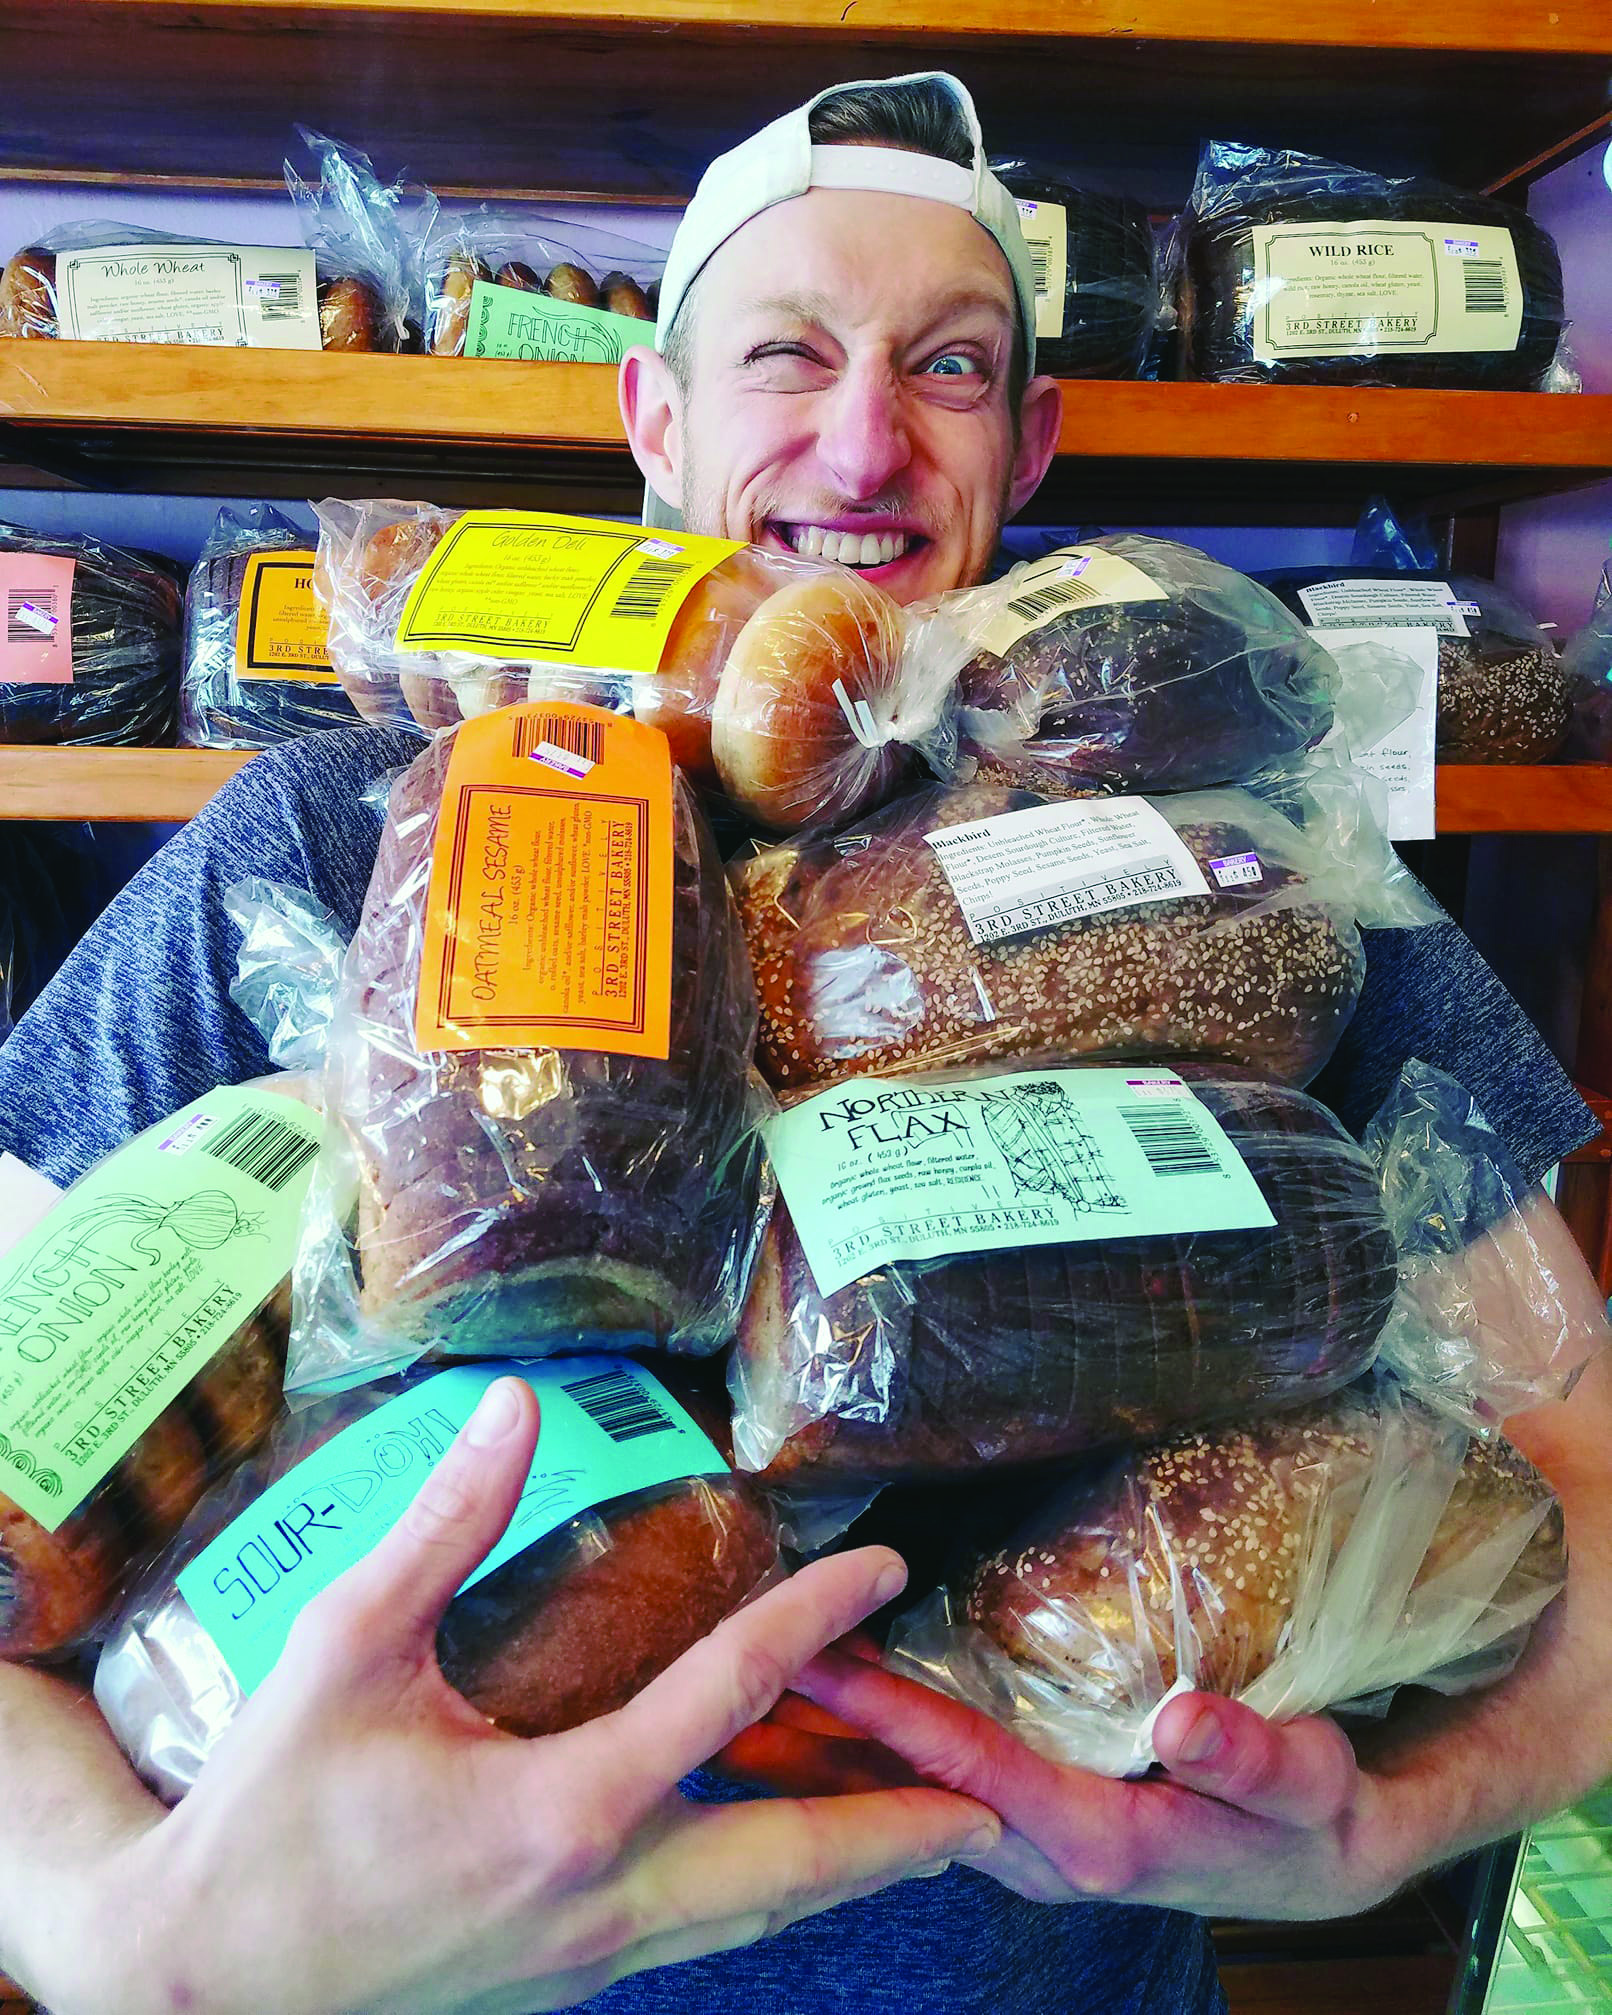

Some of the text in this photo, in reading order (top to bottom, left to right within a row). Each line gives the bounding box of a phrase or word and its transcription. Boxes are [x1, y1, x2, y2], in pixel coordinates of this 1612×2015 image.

[1310, 245, 1394, 256] WILD RICE
[102, 260, 205, 278] Whole Wheat
[508, 313, 587, 352] FRENCH
[1286, 322, 1310, 331] 3RD
[1317, 320, 1363, 329] STREET
[492, 531, 588, 550] Golden Deli
[1306, 582, 1345, 592] Blackbird
[932, 828, 991, 850] Blackbird
[938, 845, 985, 862] Ingredients:
[987, 832, 1034, 847] Unbleached
[1034, 826, 1060, 835] Wheat
[975, 852, 1004, 862] Desem
[1005, 840, 1048, 855] Sourdough
[1080, 824, 1111, 836] Filtered
[513, 865, 525, 874] g)
[950, 866, 993, 882] Blackstrap
[1035, 846, 1070, 858] Pumpkin
[984, 874, 1010, 886] Poppy
[1036, 859, 1066, 870] Sesame
[511, 876, 521, 895] (453
[975, 869, 1175, 934] 3RD STREET BAKERY
[472, 805, 511, 1000] OATMEAL SESAME
[508, 914, 518, 924] 16
[605, 821, 626, 997] 3RD STREET BAKERY
[1010, 922, 1028, 932] 3RD
[1048, 904, 1087, 920] DULUTH,
[1087, 899, 1101, 908] MN
[847, 1111, 971, 1150] FLAX
[832, 1207, 1056, 1261] 3RD STREET BAKERY
[17, 1255, 138, 1363] ONION
[176, 1339, 197, 1360] 55805
[65, 1289, 233, 1461] 3RD STREET BAKERY
